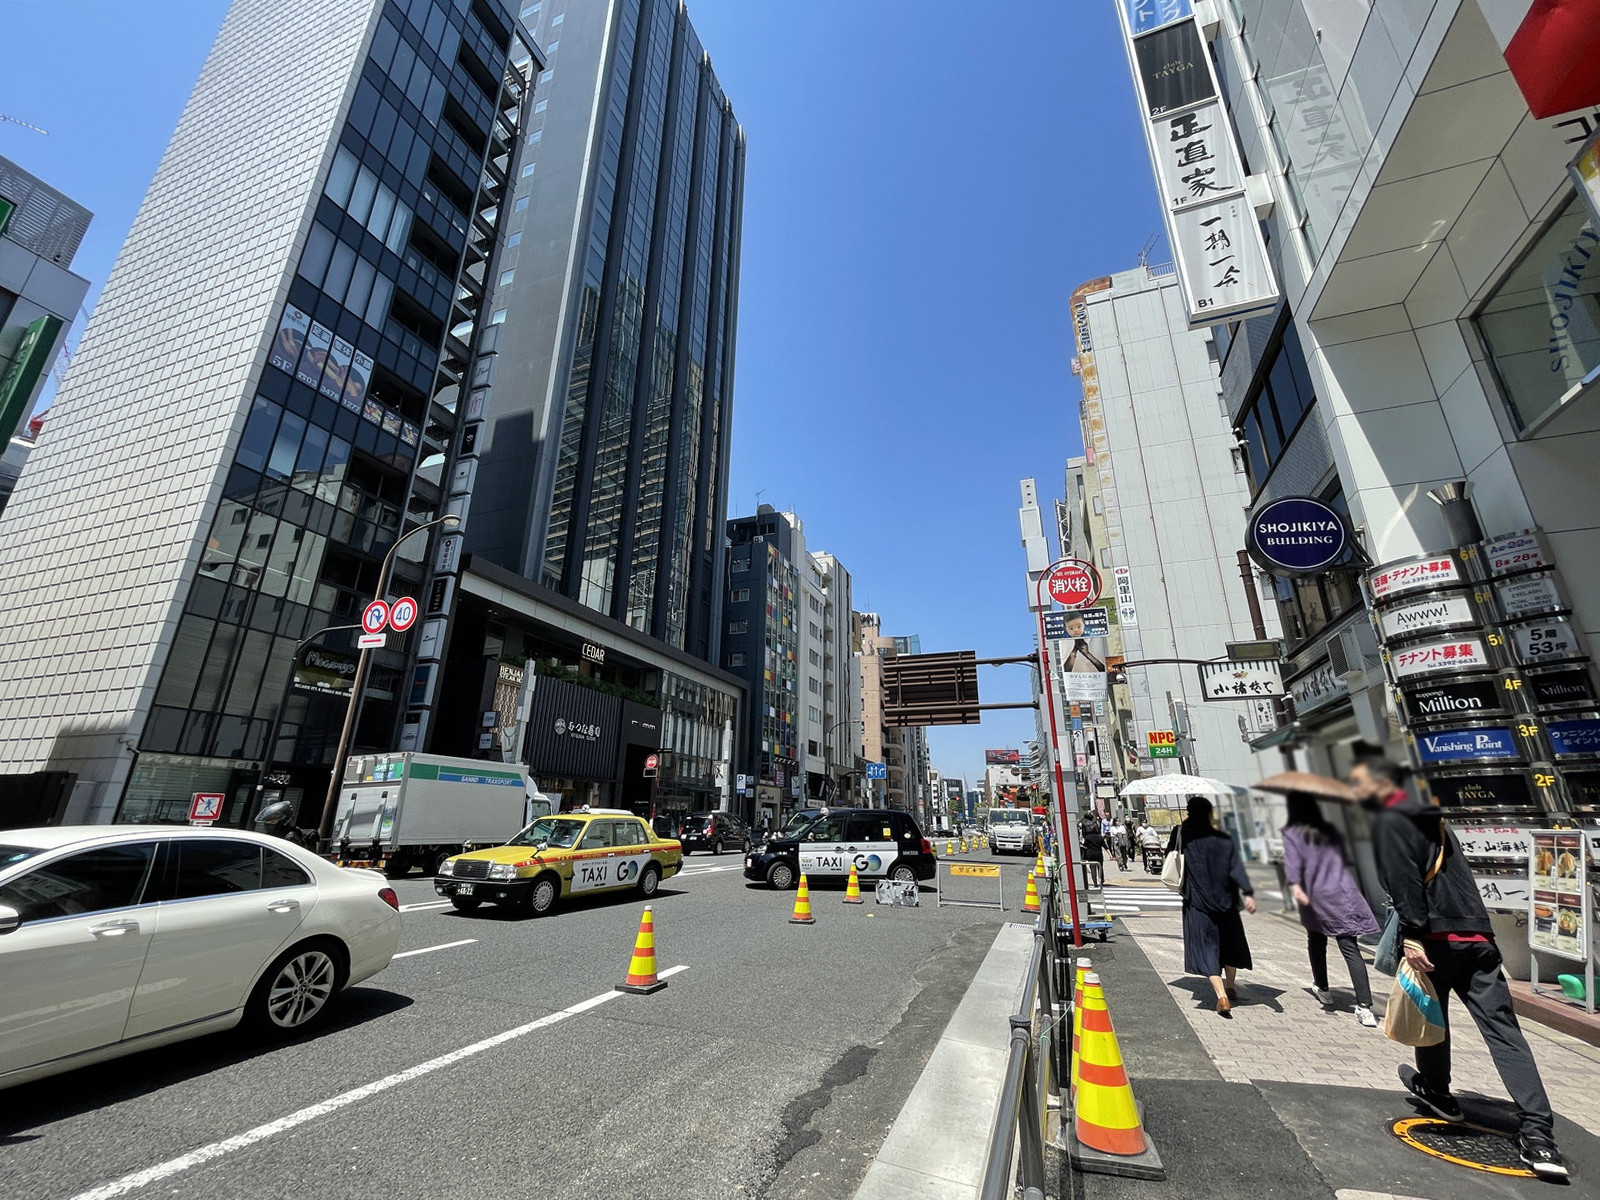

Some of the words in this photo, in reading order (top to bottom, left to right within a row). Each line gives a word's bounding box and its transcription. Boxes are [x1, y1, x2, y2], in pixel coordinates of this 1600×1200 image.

[1153, 62, 1195, 80] TAYGA
[1152, 105, 1167, 115] 2F
[1170, 113, 1233, 197] 正直家
[1173, 197, 1187, 206] 1F
[1199, 216, 1241, 288] 一期一会
[1198, 298, 1214, 308] B1
[272, 355, 293, 370] 5F
[1259, 521, 1338, 534] SHOJIKIYA
[1266, 534, 1333, 546] BUILDING
[1374, 560, 1452, 588] 店舗・テナント募集
[1051, 576, 1089, 594] 消火栓
[1117, 576, 1132, 604] 阿里山
[395, 606, 411, 621] 40
[1397, 603, 1449, 625] Awww!
[582, 643, 605, 662] CEDAR
[1399, 643, 1473, 667] テナント募集
[1504, 678, 1522, 691] 4F
[1419, 695, 1482, 713] Million
[1148, 731, 1175, 744] NPC
[1518, 724, 1539, 737] 3F
[1424, 736, 1474, 753] Vanishing
[1474, 735, 1502, 749] Point
[737, 775, 744, 783] P
[1534, 773, 1555, 787] 2F
[1456, 790, 1496, 799] TAYGA
[1464, 783, 1482, 791] club
[816, 856, 843, 868] TAXI
[581, 866, 608, 884] TAXI
